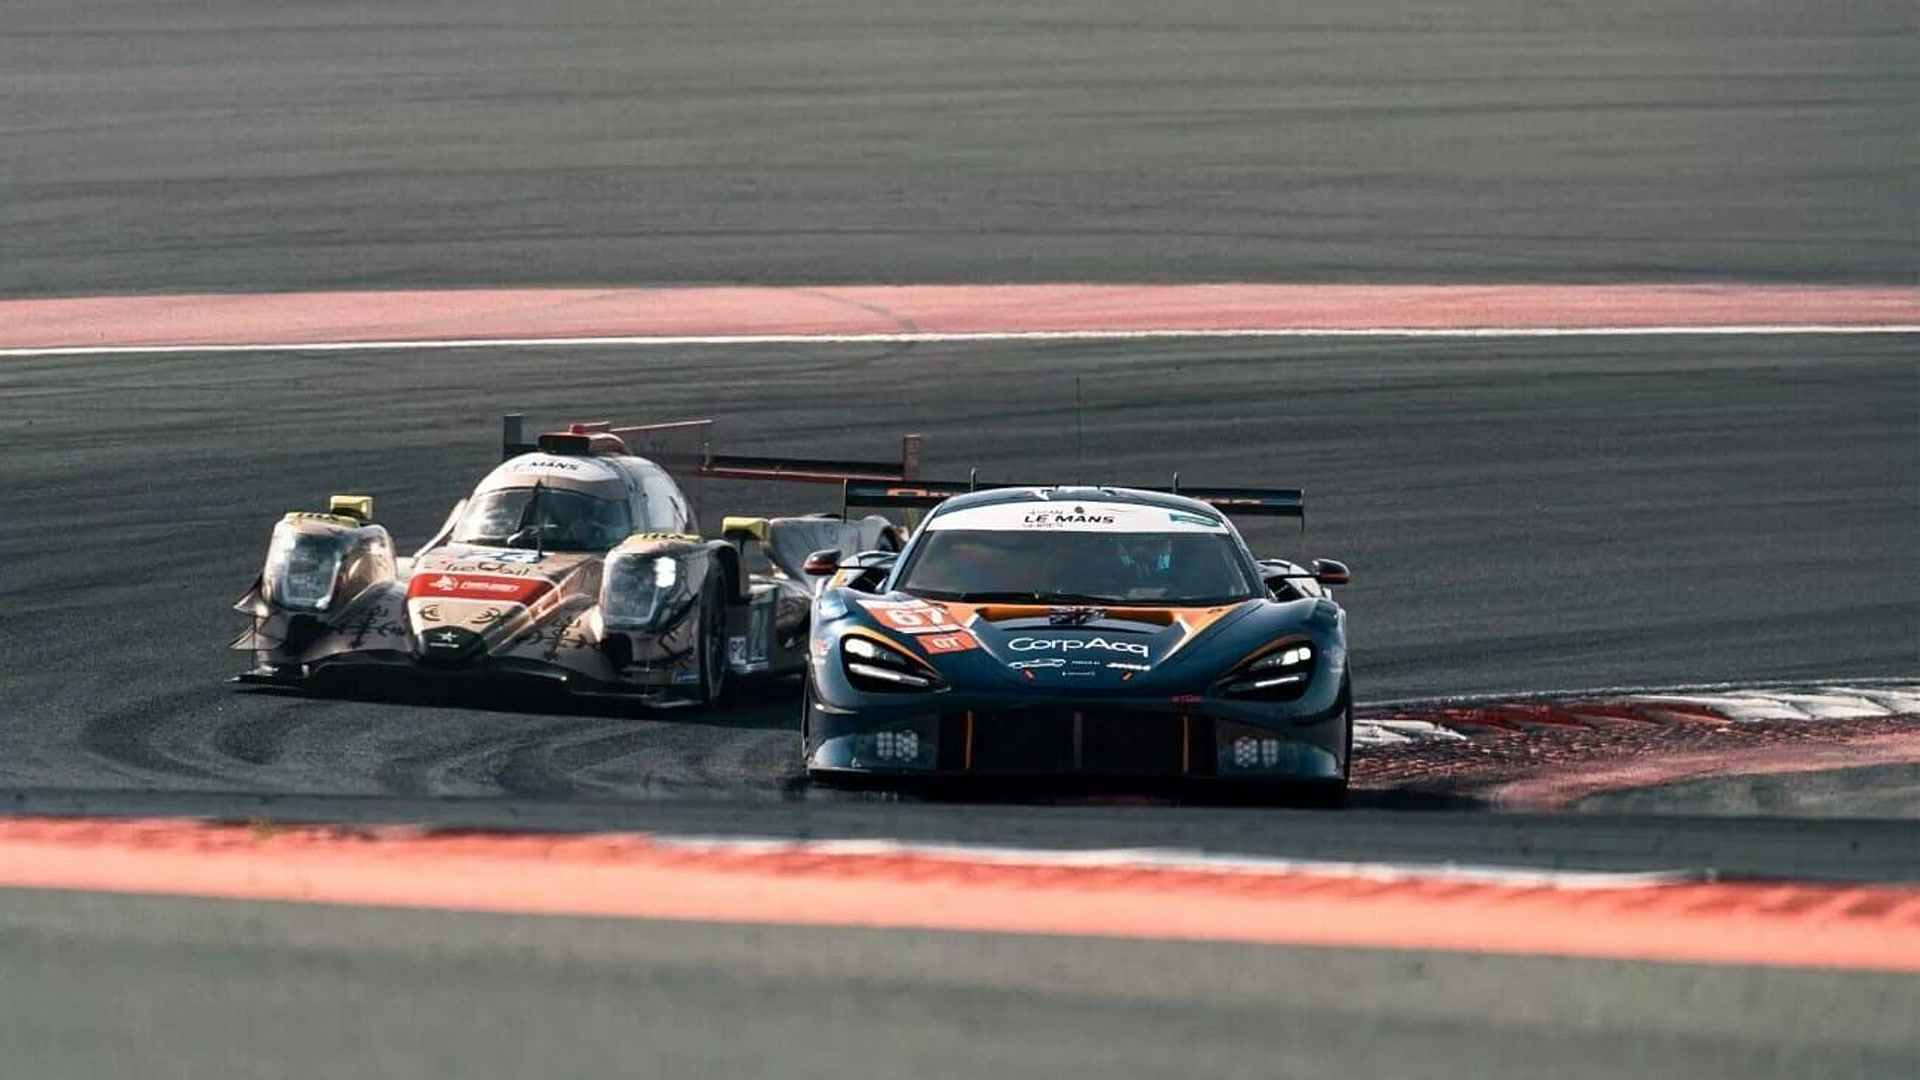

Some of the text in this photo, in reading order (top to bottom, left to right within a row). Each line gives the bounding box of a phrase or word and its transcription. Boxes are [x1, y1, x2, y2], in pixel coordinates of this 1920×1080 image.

[1024, 515, 1115, 524] LE MANS
[886, 606, 944, 626] 67
[1008, 637, 1149, 658] CorpAcq
